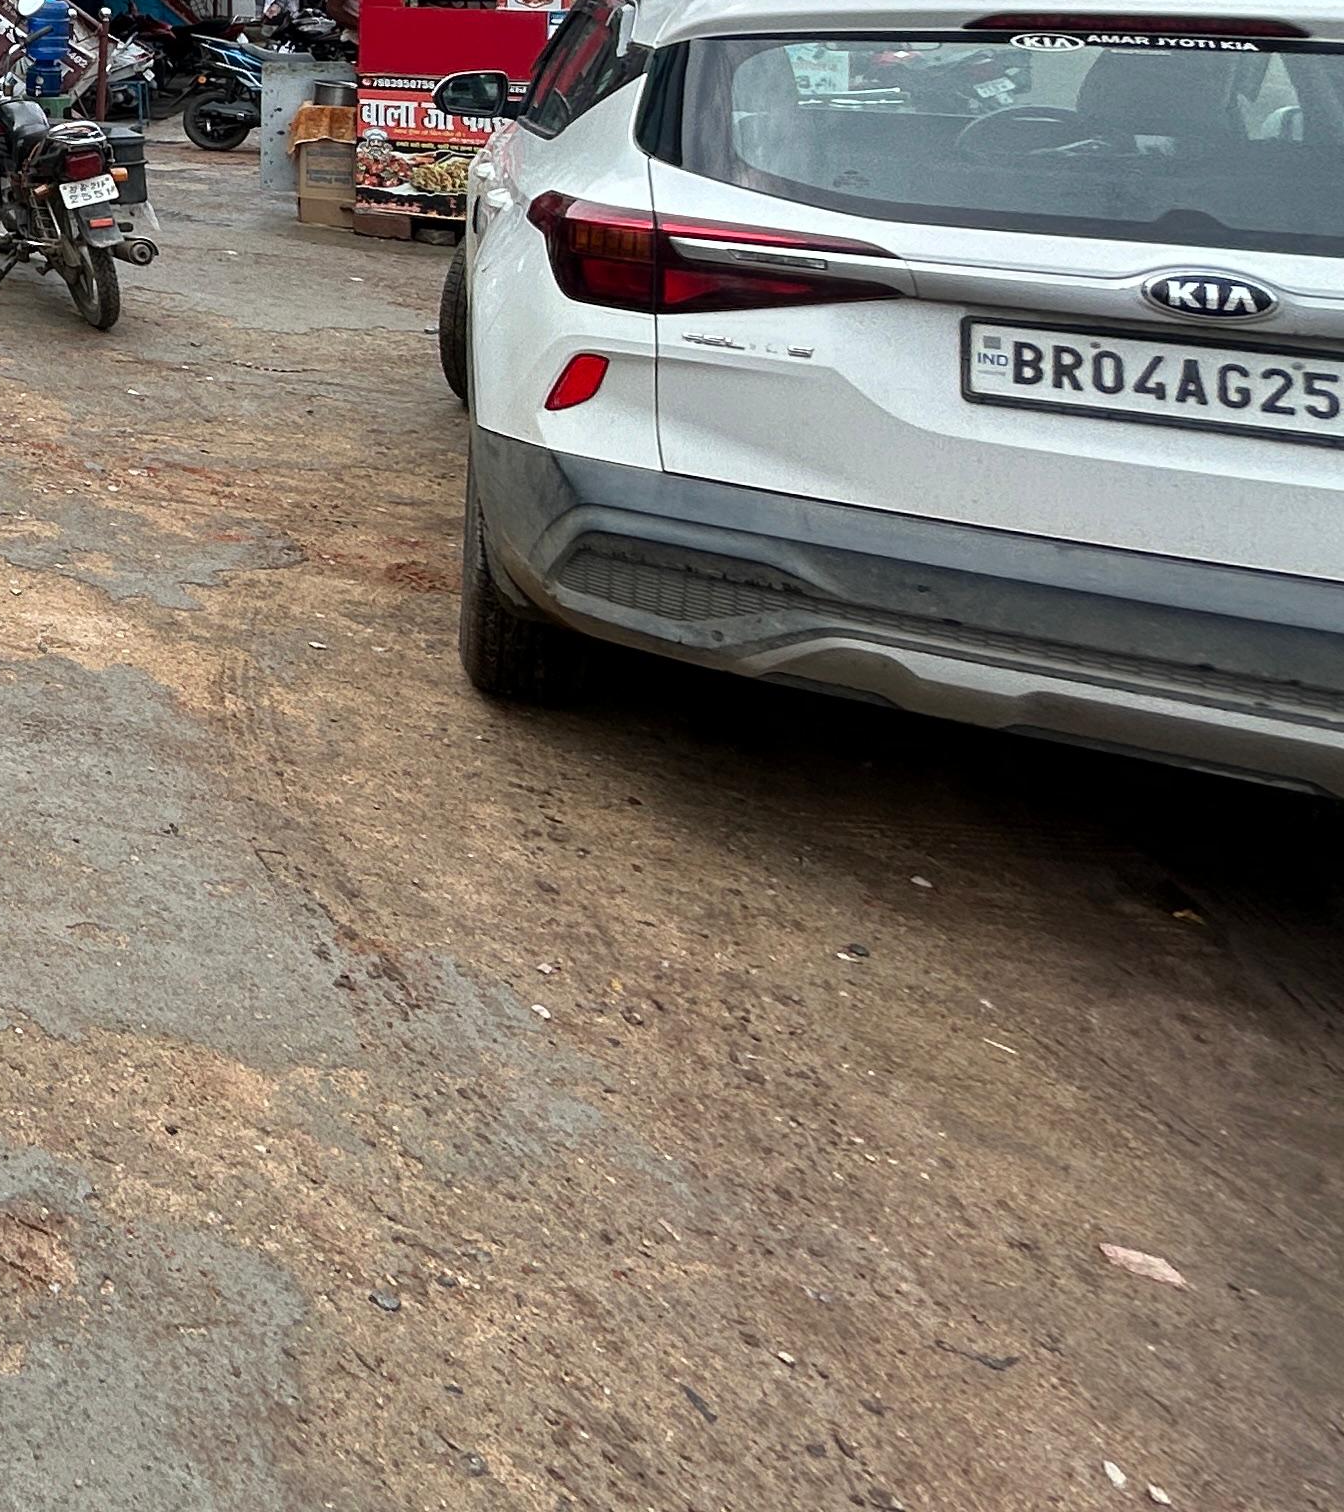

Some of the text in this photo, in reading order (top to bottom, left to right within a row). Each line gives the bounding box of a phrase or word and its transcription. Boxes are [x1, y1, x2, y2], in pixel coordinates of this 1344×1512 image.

[1023, 35, 1260, 51] KIA AMAR JYOTI KIA
[359, 98, 419, 128] बाला
[1165, 280, 1259, 313] KIA
[977, 352, 1009, 366] IND
[1012, 340, 1342, 420] BR04AG25
